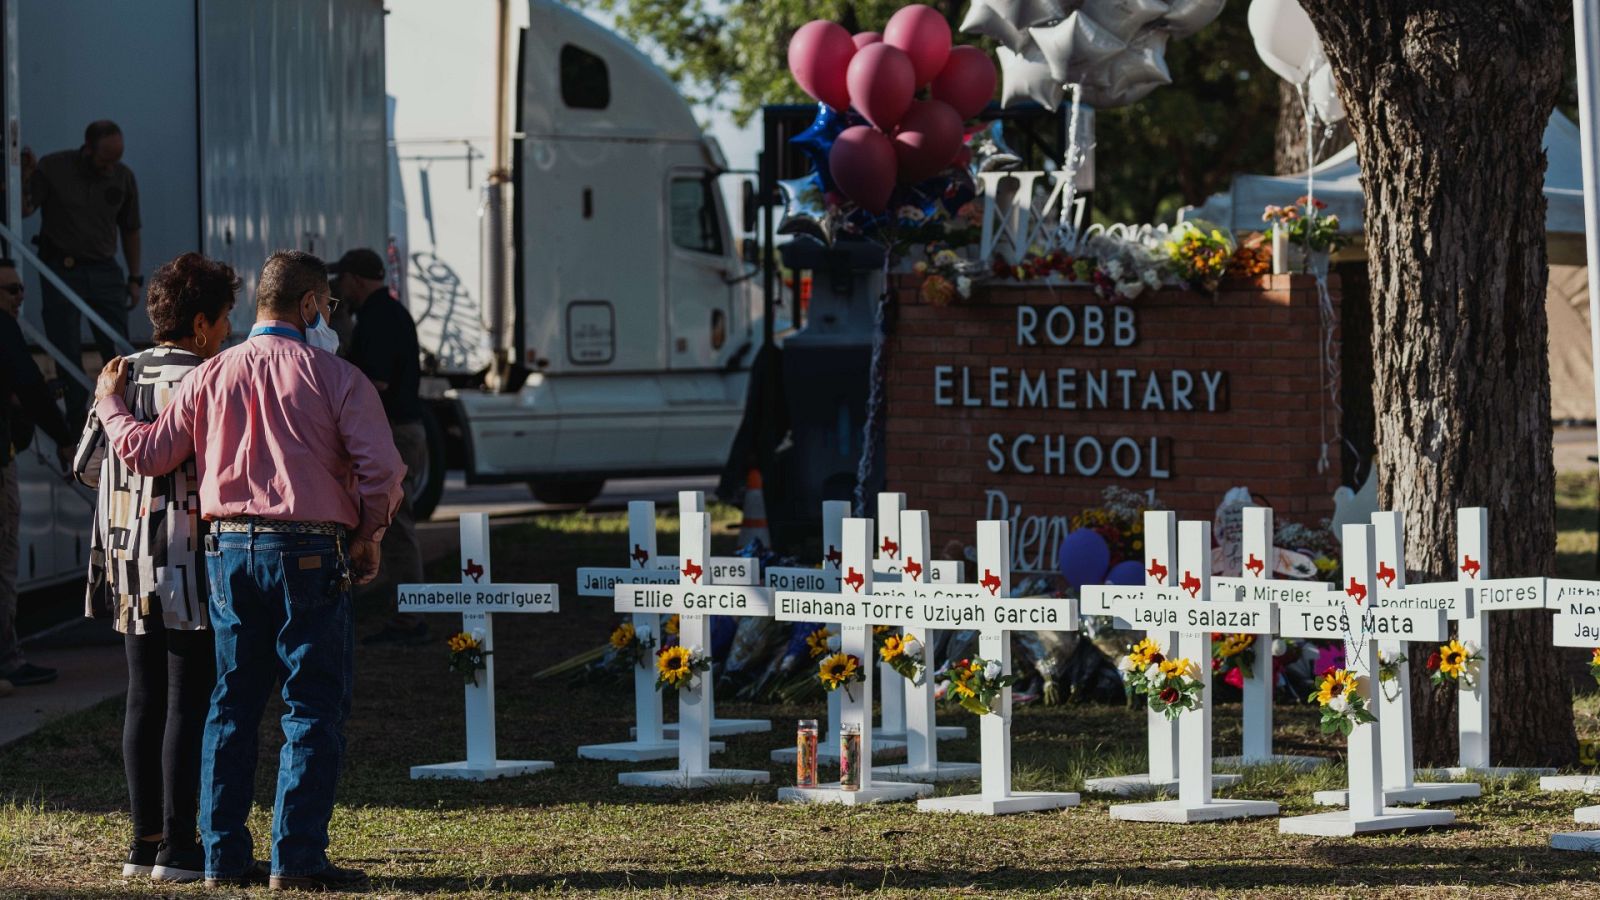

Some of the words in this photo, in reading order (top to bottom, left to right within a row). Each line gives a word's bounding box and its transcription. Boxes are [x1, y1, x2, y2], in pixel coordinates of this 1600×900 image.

[1016, 305, 1137, 347] ROBB
[934, 365, 1223, 411] ELEMENTARY
[986, 433, 1170, 479] SCHOOL
[399, 591, 471, 605] Annabelle
[476, 592, 552, 608] Rodriguez
[634, 590, 673, 608] Ellie
[683, 592, 747, 609] Garcia
[1480, 586, 1537, 605] Flores
[781, 599, 856, 616] Eliahana
[862, 602, 914, 619] Torre
[923, 605, 984, 625] Uziyah
[994, 606, 1058, 624] Garcia
[1135, 607, 1177, 627] Layla
[1187, 609, 1260, 627] Salazar
[1301, 612, 1350, 632] Tess
[1361, 614, 1414, 633] Mata
